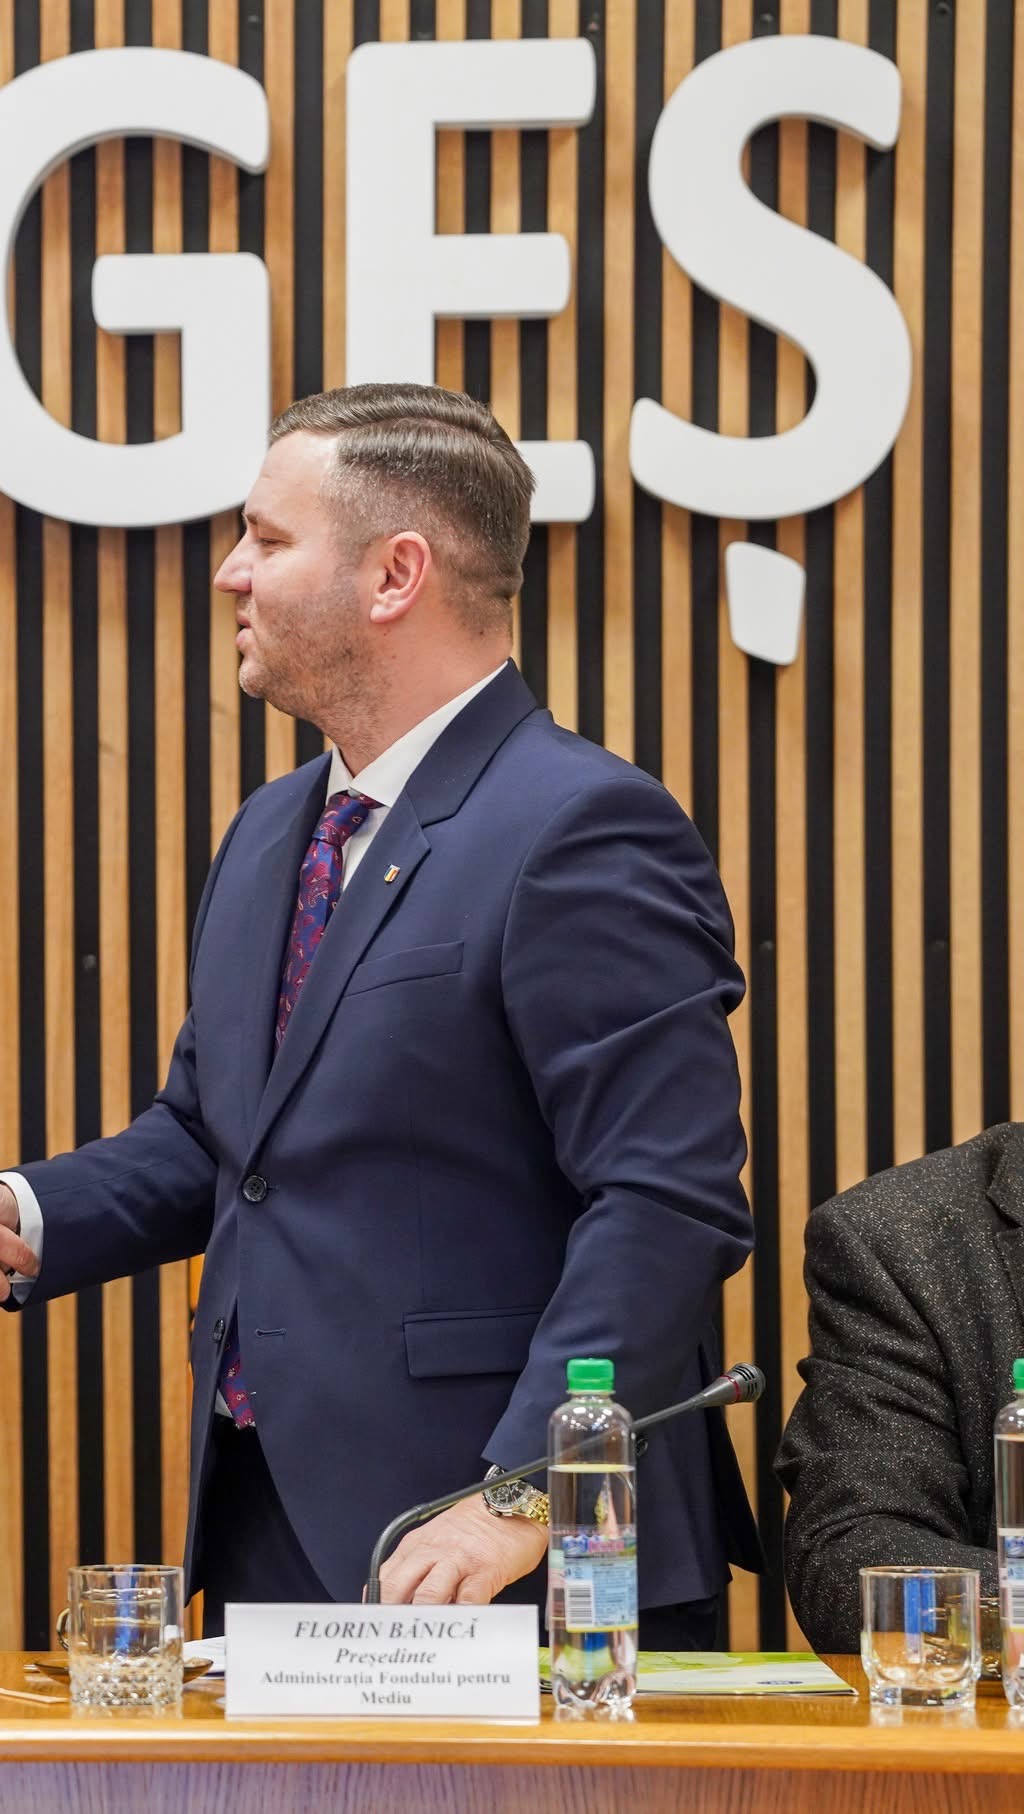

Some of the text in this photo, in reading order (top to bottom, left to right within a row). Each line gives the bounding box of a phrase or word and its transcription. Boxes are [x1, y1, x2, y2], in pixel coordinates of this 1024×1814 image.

[295, 1617, 479, 1640] FLORIN BĂNICĂ
[335, 1647, 437, 1667] Președinte
[261, 1671, 511, 1686] Administrația Fondului pentru
[360, 1691, 412, 1705] Mediu
